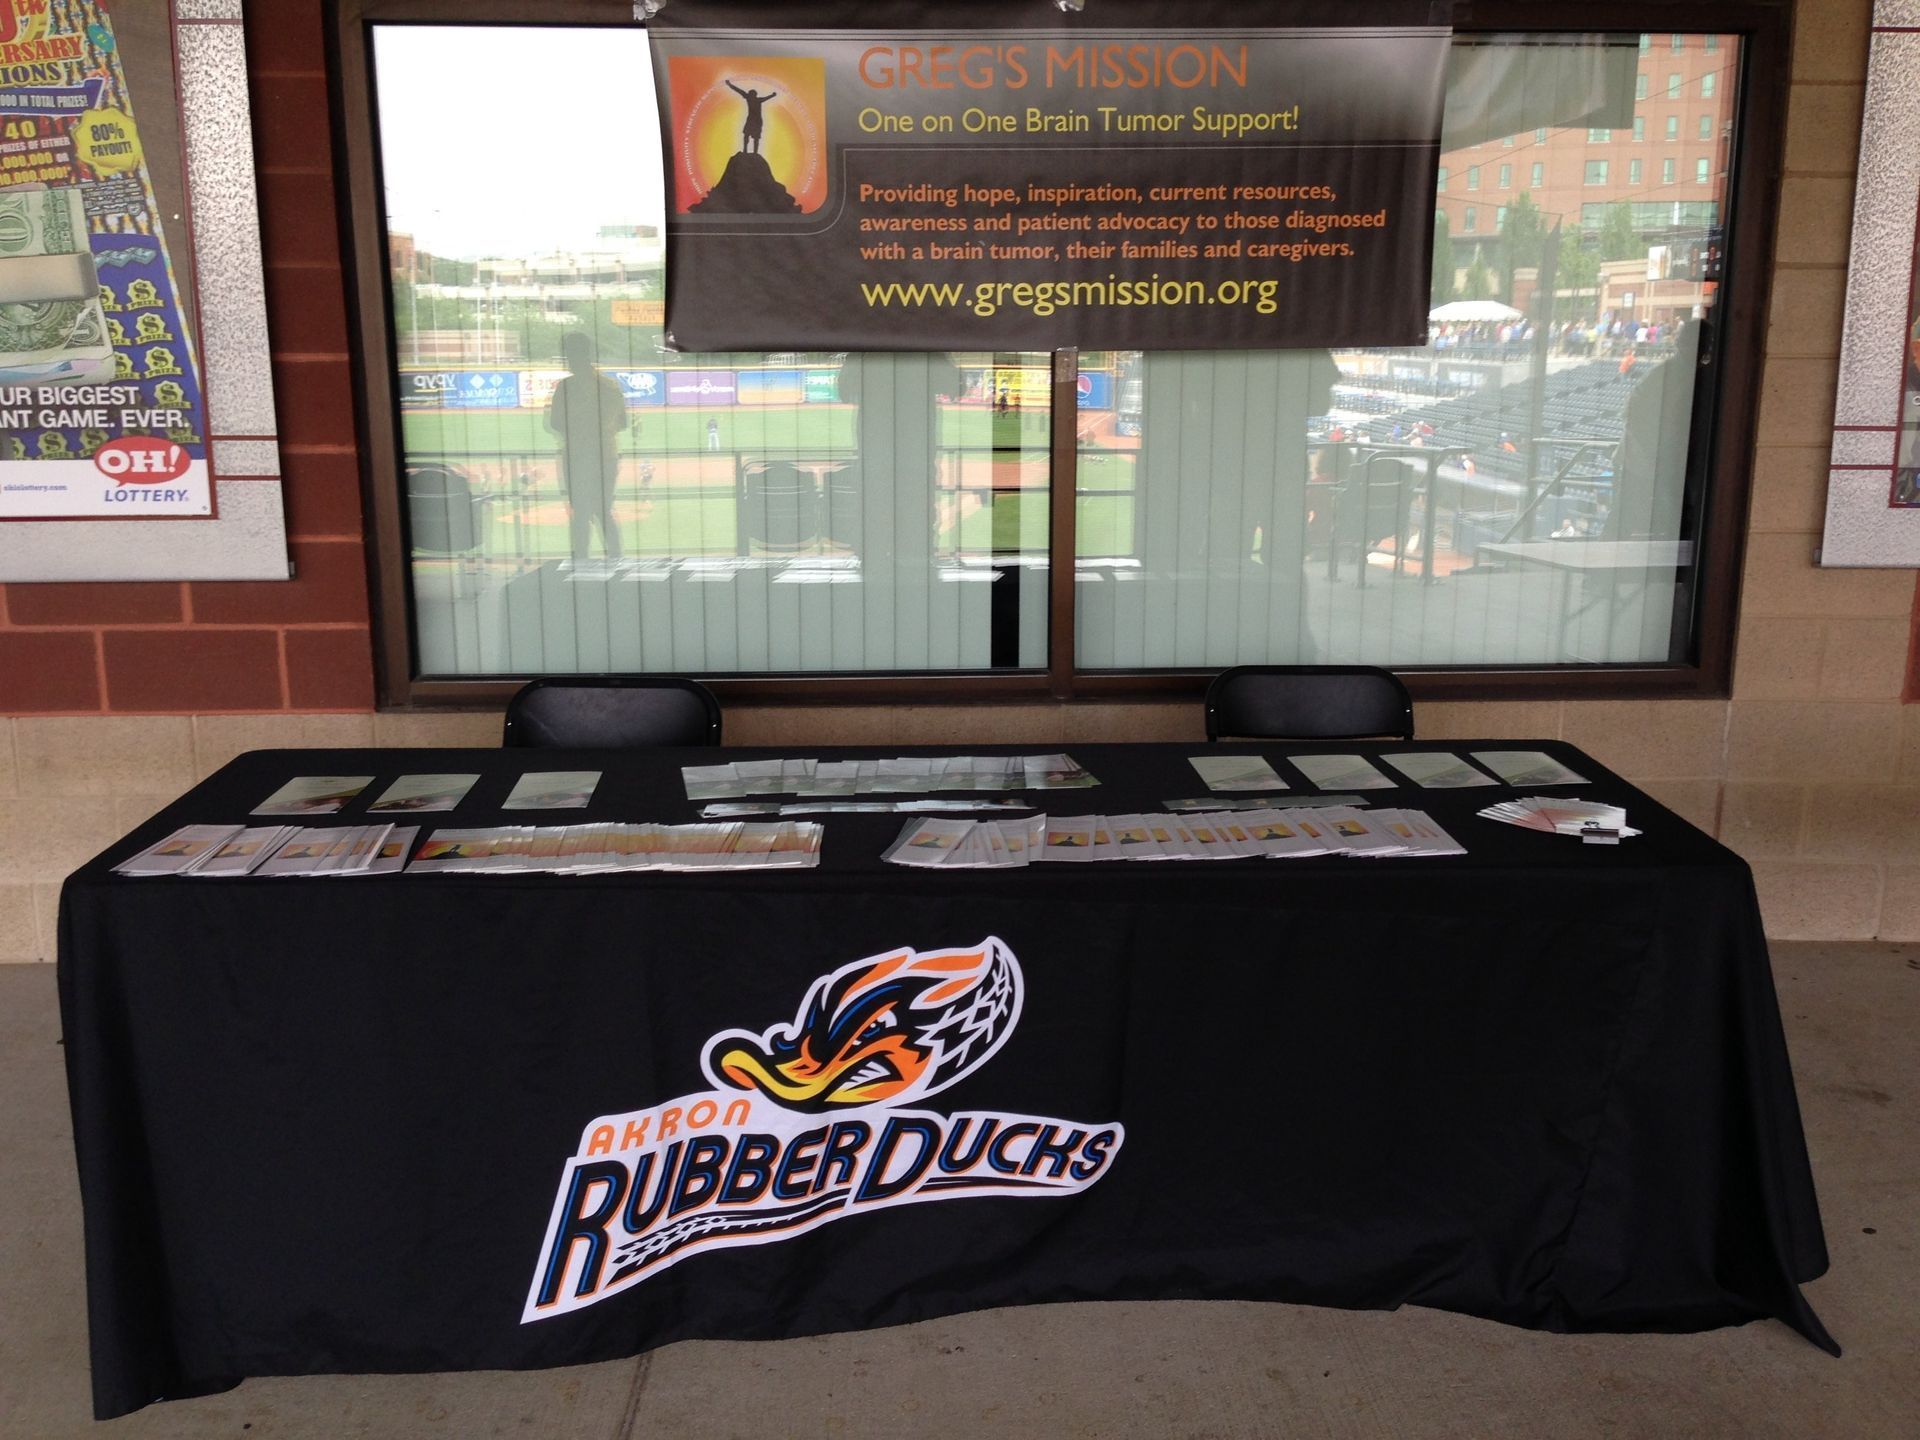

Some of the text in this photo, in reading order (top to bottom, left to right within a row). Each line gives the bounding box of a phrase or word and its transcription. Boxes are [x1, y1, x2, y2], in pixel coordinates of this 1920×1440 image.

[0, 36, 83, 64] RSARY
[0, 62, 62, 84] IONS
[858, 45, 1248, 89] GREG'S MISSION
[30, 95, 56, 108] TOTAL
[56, 95, 89, 108] PRIZES!
[5, 120, 37, 140] 40
[90, 122, 125, 142] 80%
[858, 105, 1299, 138] One on One Brain Tumor Support!
[40, 136, 71, 149] EITHER
[90, 140, 134, 158] PAYOUT!
[859, 183, 1337, 207] Providing hope, inspiration, current resources,
[859, 210, 1387, 235] awareness and patient advocacy to those diagnosed
[860, 239, 1355, 262] with a brain tumor, their families and caregivers.
[860, 273, 1279, 317] www.gregsmission.org
[38, 387, 139, 405] BIGGEST
[0, 409, 190, 428] NT GAME. EVER.
[99, 445, 181, 474] OH!
[105, 490, 187, 502] LOTTERY
[587, 1098, 752, 1155] AKRON
